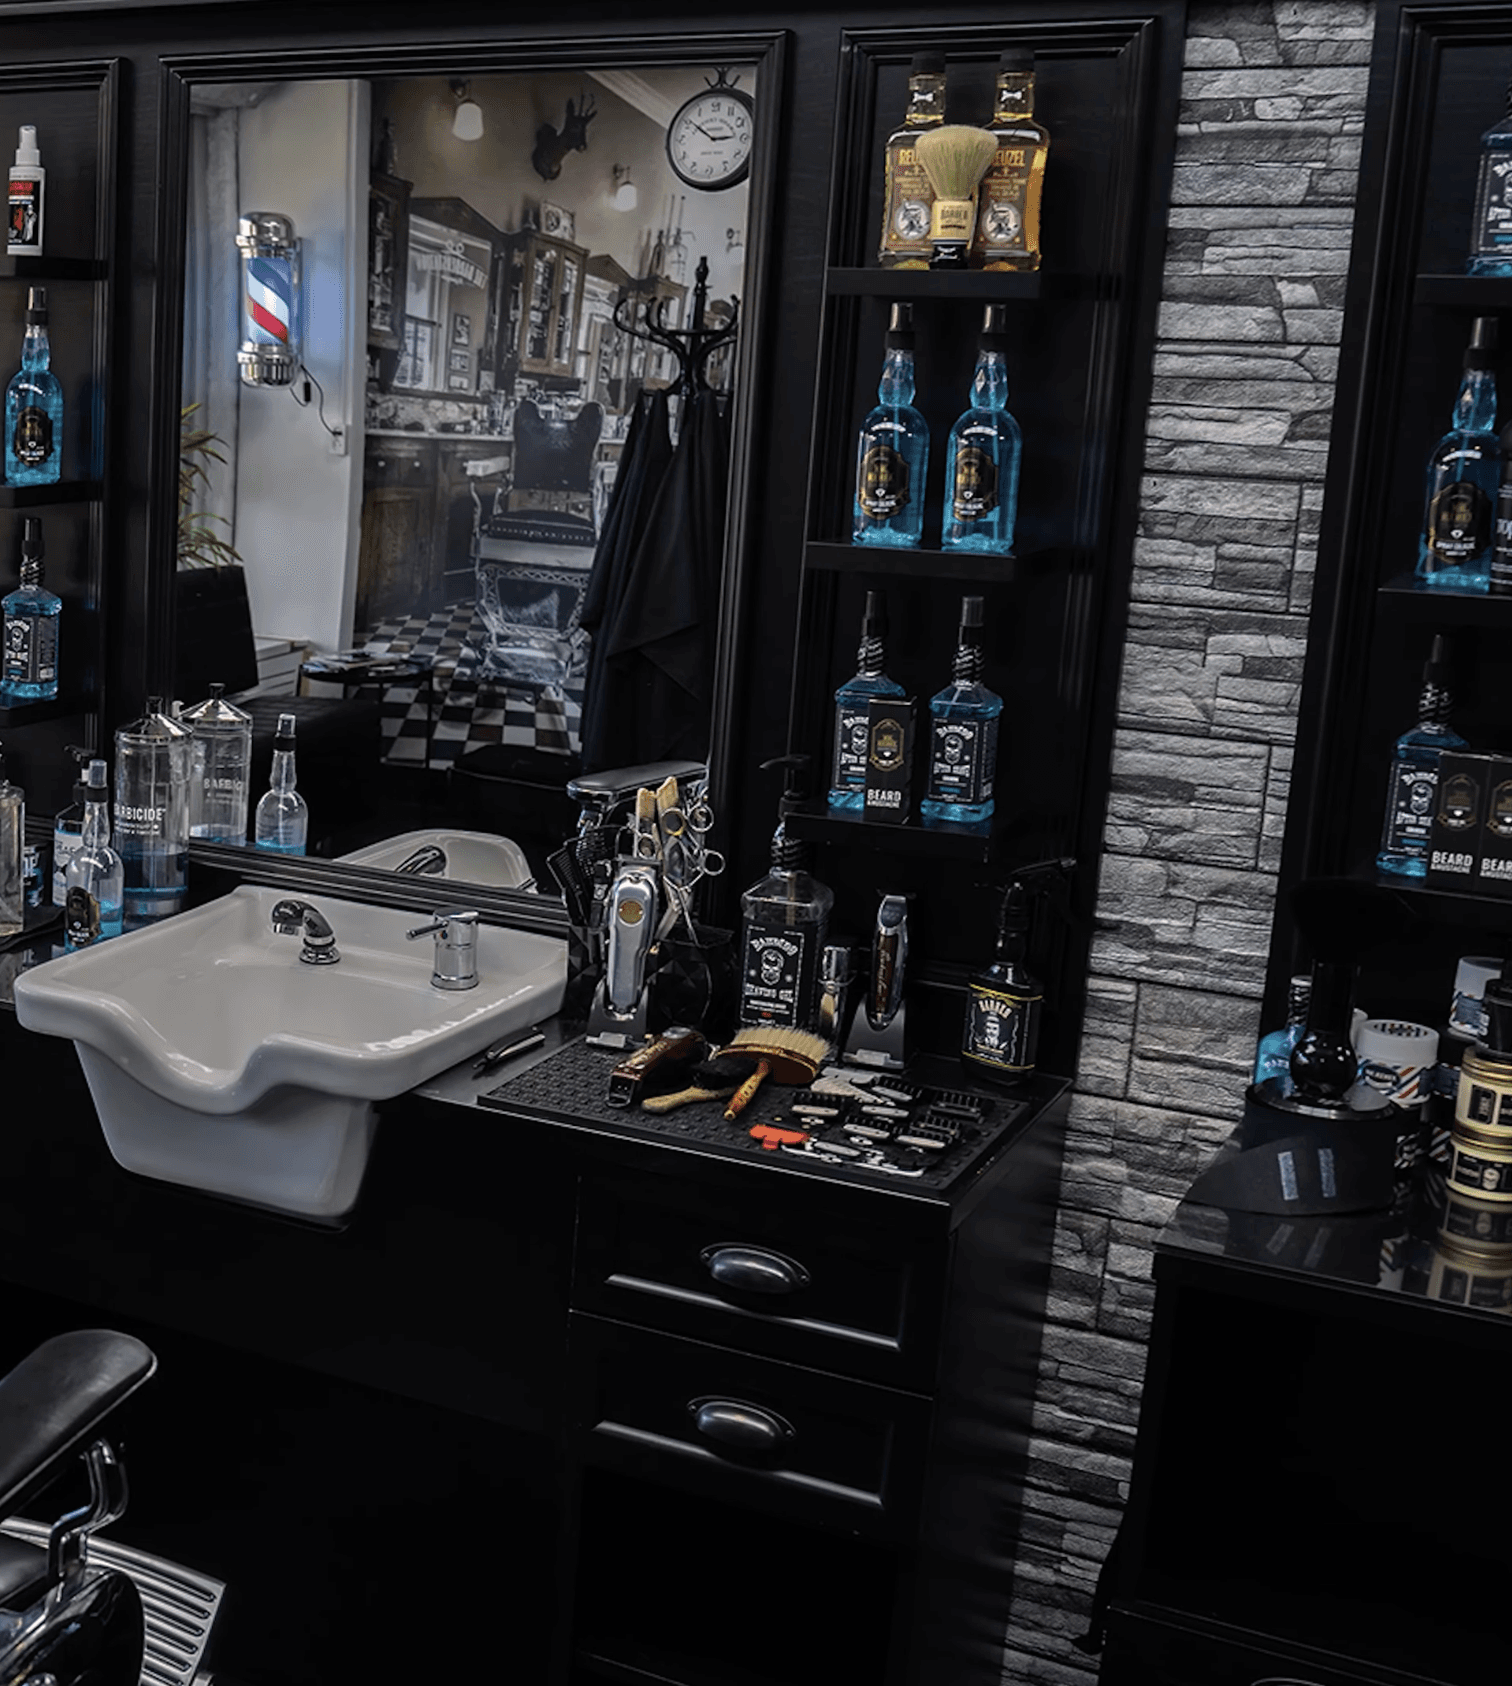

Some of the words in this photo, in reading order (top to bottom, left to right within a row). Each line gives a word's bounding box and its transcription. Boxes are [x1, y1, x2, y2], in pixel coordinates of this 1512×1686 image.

[867, 788, 902, 803] BEARD
[1431, 850, 1474, 868] BEARD
[1481, 857, 1512, 872] BEAR
[978, 999, 1013, 1020] BARBER
